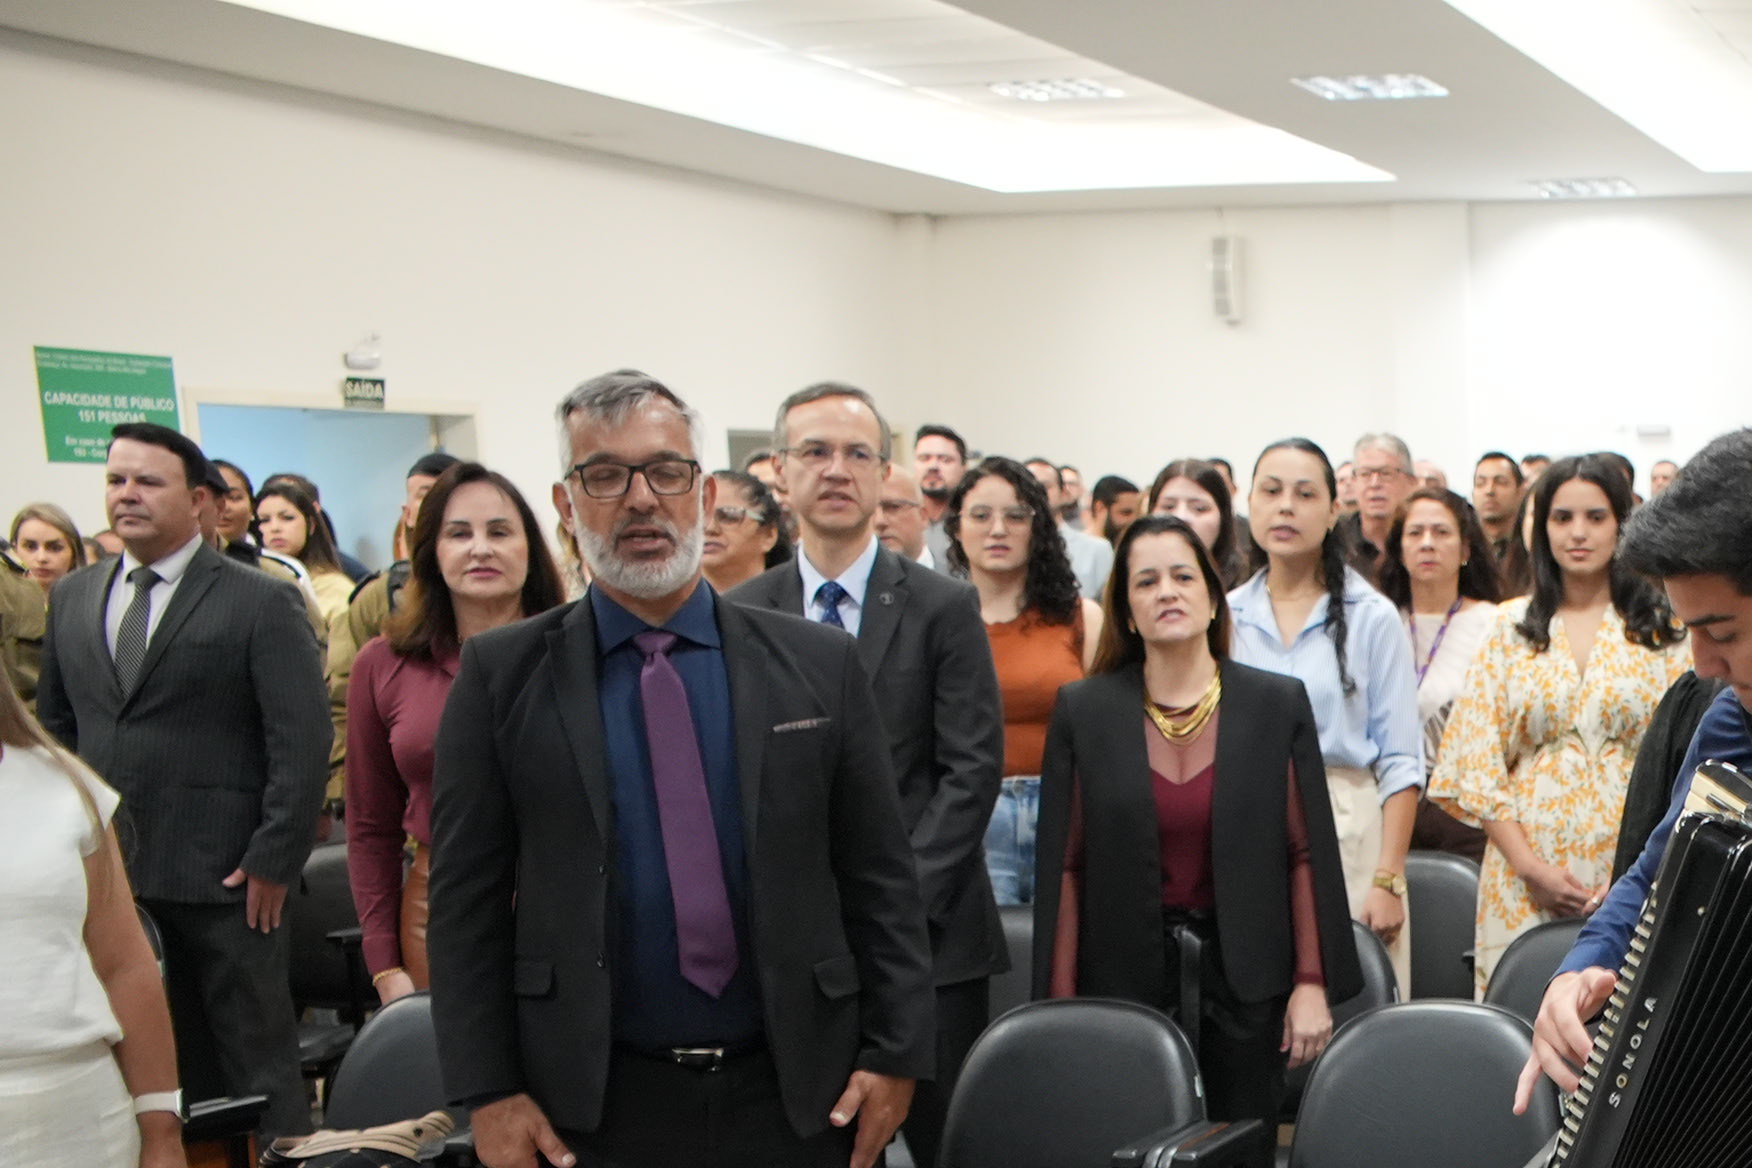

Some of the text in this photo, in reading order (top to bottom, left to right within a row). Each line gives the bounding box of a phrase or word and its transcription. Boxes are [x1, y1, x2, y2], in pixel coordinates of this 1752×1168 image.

[346, 379, 384, 398] SAÍDA
[44, 391, 176, 412] CAPACIDADE DE PÚBLICO
[79, 409, 147, 425] 151 PESSOAS
[1608, 996, 1657, 1109] SONOLA
